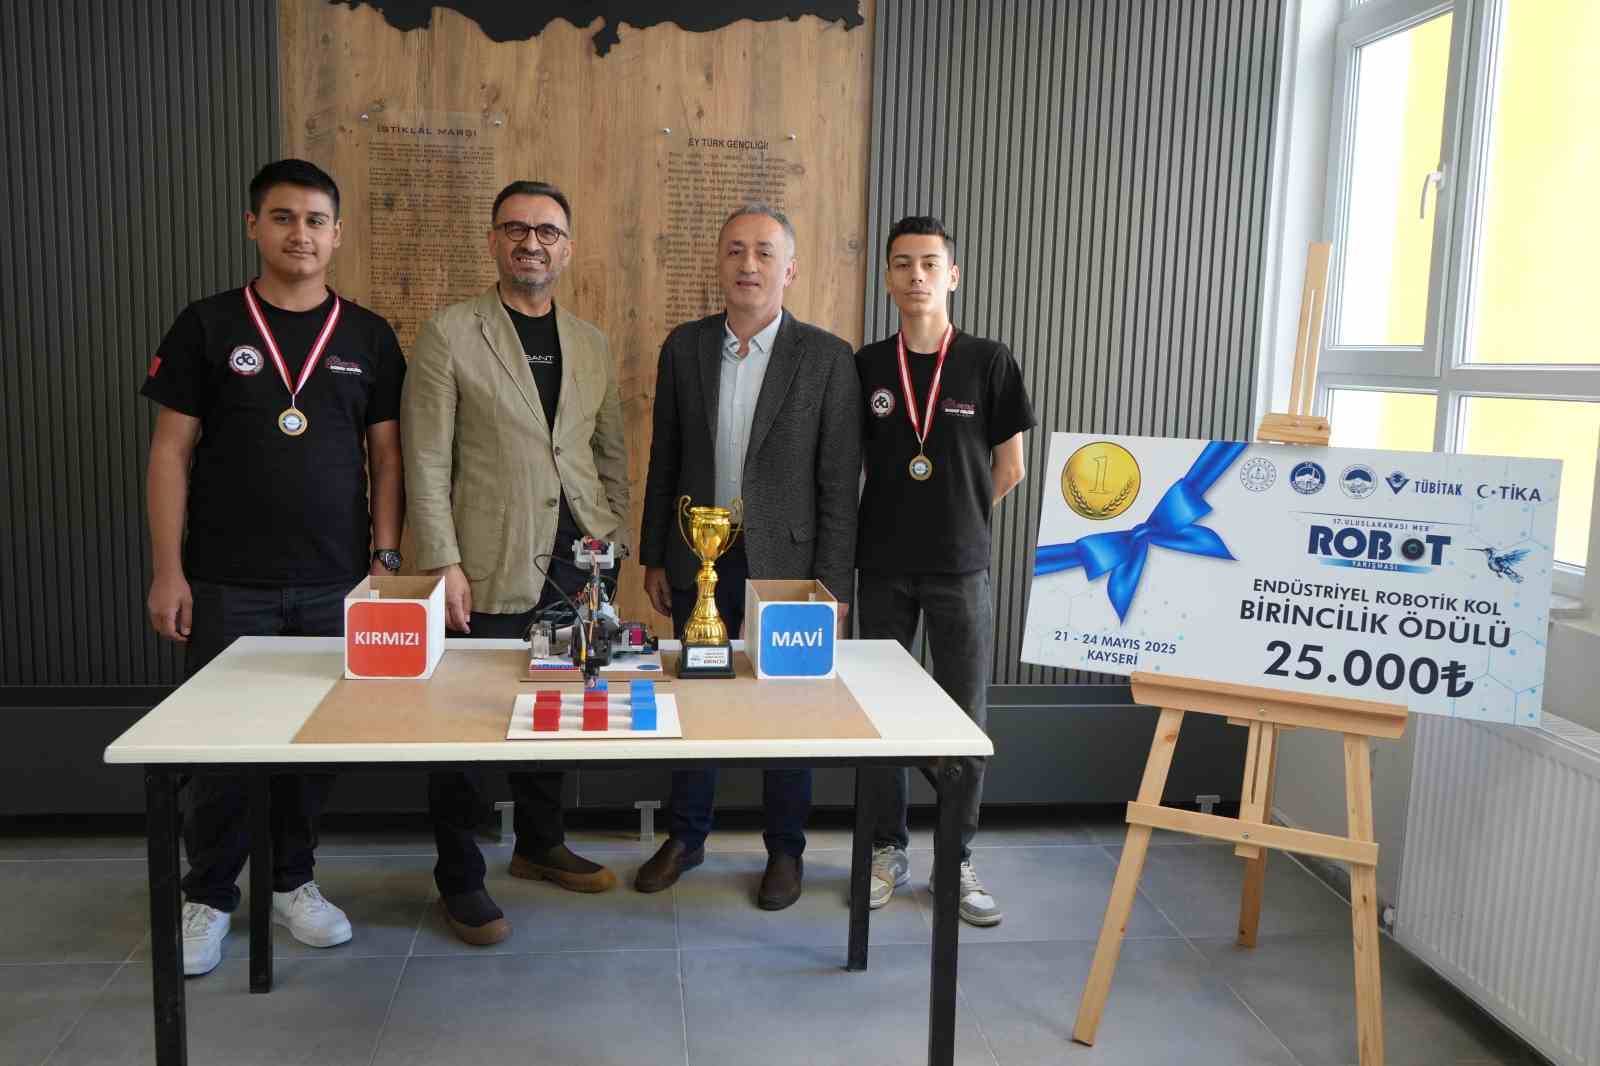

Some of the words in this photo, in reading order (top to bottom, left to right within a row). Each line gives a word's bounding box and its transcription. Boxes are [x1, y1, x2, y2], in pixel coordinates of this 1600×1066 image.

[688, 138, 700, 147] EY
[702, 138, 724, 148] TÜRK
[1088, 455, 1112, 495] 1
[1415, 479, 1463, 497] TÜBİTAK
[1308, 524, 1451, 565] ROBOT
[1253, 578, 1369, 602] ENDÜSTRİYEL
[1375, 590, 1457, 612] ROBOTİK
[1464, 599, 1502, 616] KOL
[1239, 595, 1390, 635] BİRİNCİLİK
[1399, 611, 1511, 648] ÖDÜLÜ
[355, 631, 420, 646] KIRMIZI
[772, 627, 823, 647] MAVİ
[1054, 630, 1068, 642] 21
[1082, 633, 1097, 645] 24
[1101, 635, 1140, 650] MAYIS
[1145, 641, 1177, 654] 2025
[1087, 649, 1138, 665] KAYSERİ
